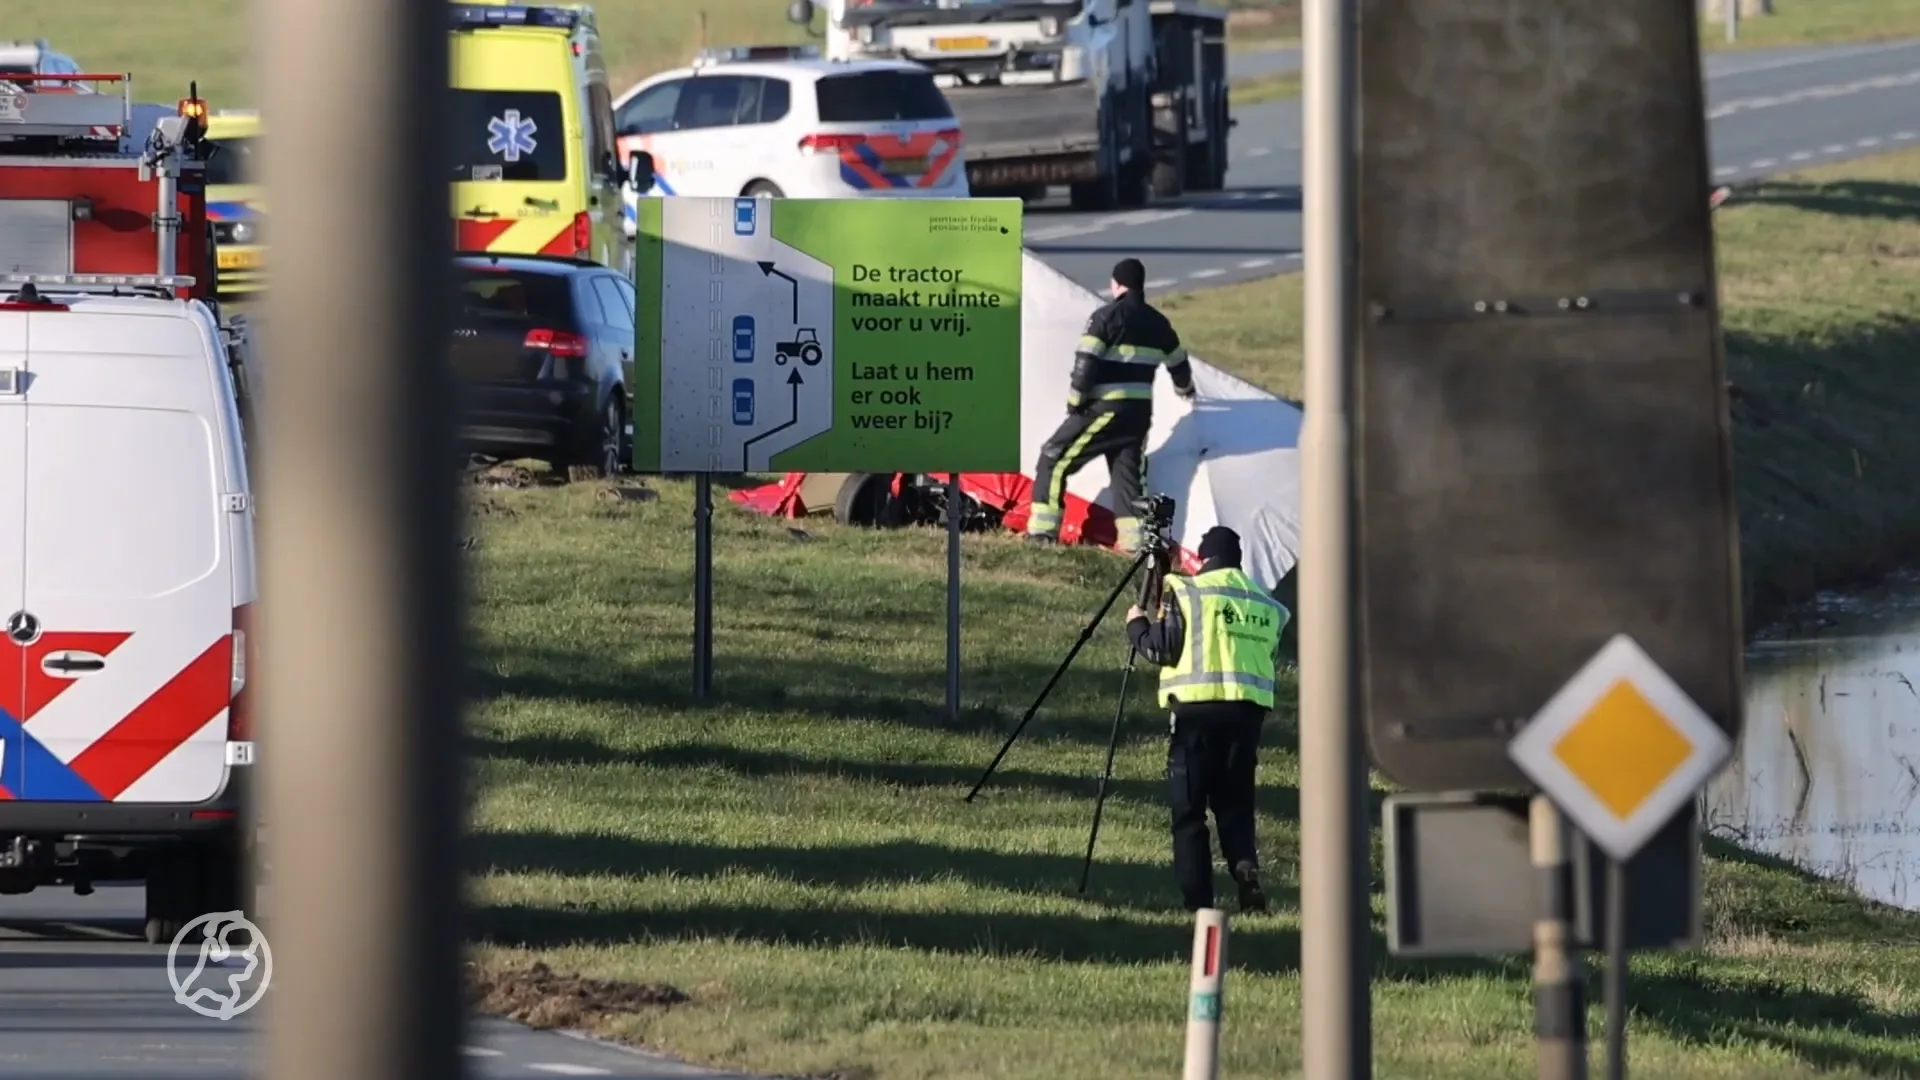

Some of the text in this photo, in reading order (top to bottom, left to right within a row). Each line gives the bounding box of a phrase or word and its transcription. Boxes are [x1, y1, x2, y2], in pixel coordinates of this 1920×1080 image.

[852, 264, 963, 283] De tractor
[851, 288, 1001, 308] maakt ruimte
[851, 313, 971, 336] voor u vrij.
[851, 361, 974, 381] Laat u hem
[851, 386, 921, 405] er ook
[851, 410, 954, 434] weer bij?
